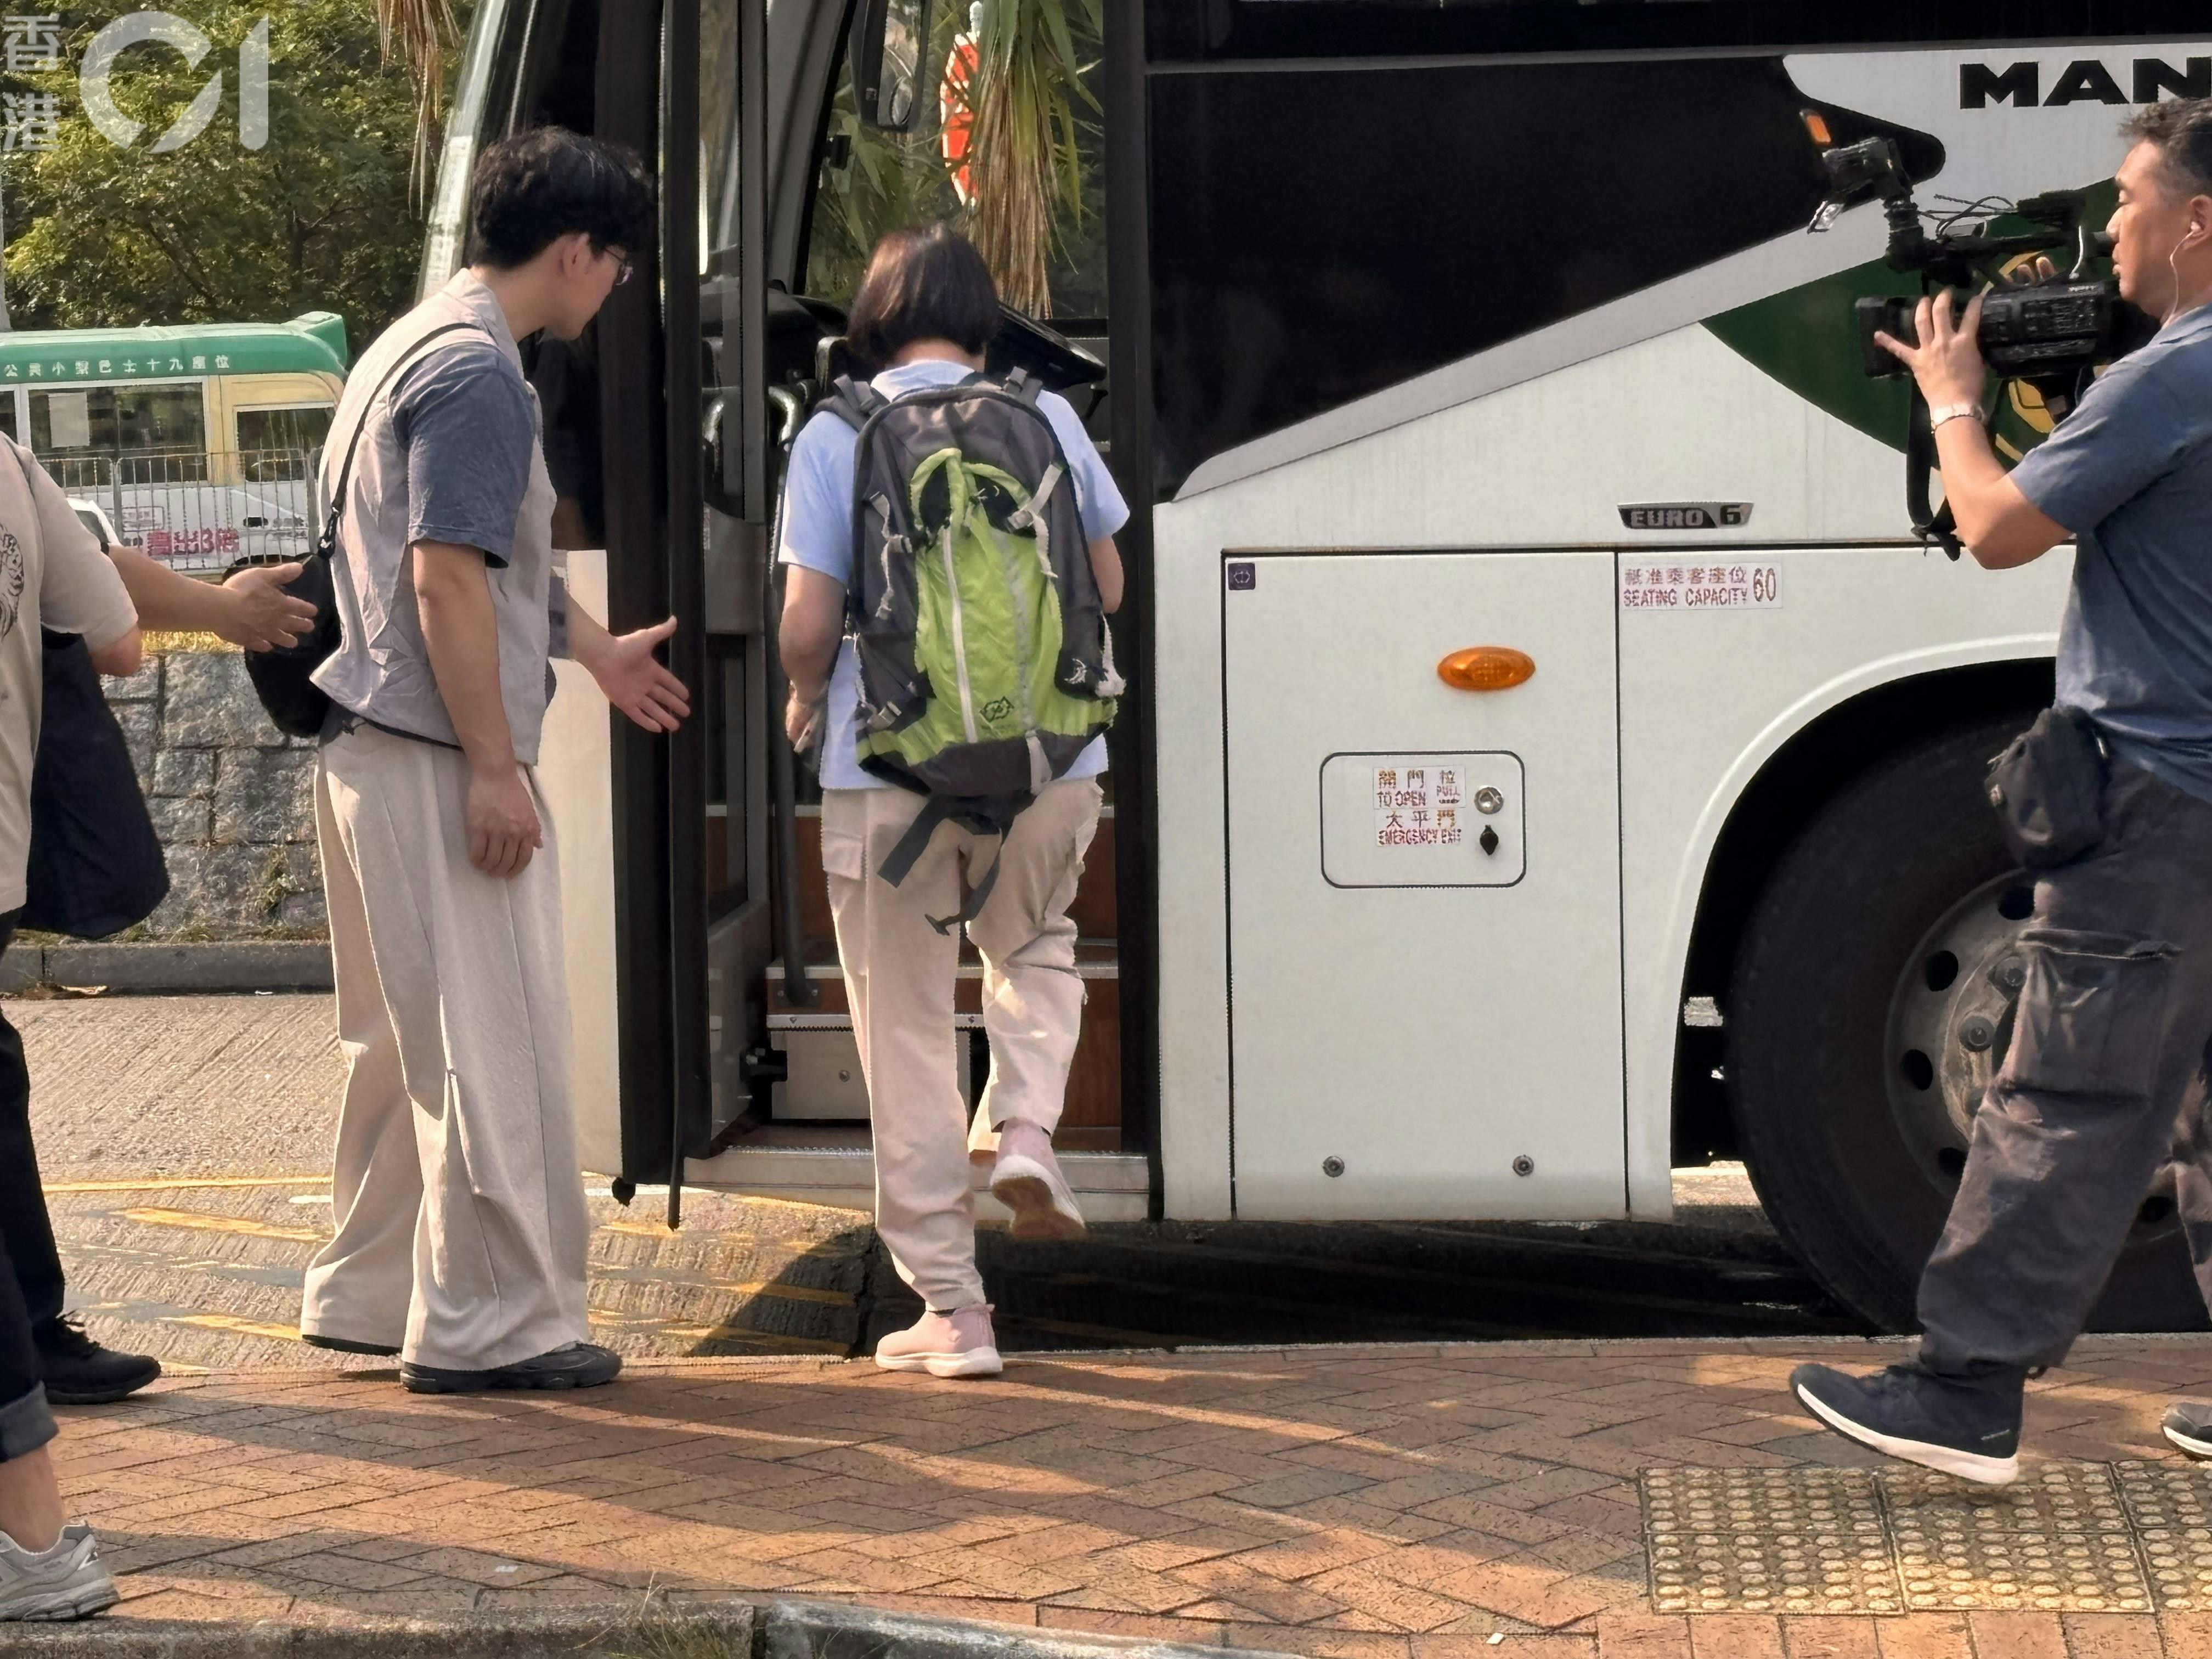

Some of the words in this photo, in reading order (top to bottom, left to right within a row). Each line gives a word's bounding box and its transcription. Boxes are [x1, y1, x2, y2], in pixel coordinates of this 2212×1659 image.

[1960, 57, 2212, 109] MAN
[1630, 509, 1704, 528] EURO
[1719, 504, 1743, 526] 6
[1753, 567, 1776, 602] 60
[1623, 588, 1678, 607] SEATING
[1685, 587, 1748, 607] CAPACITY
[1377, 791, 1392, 808] TO
[1395, 791, 1426, 807] OPEN
[1436, 785, 1461, 797] PULL
